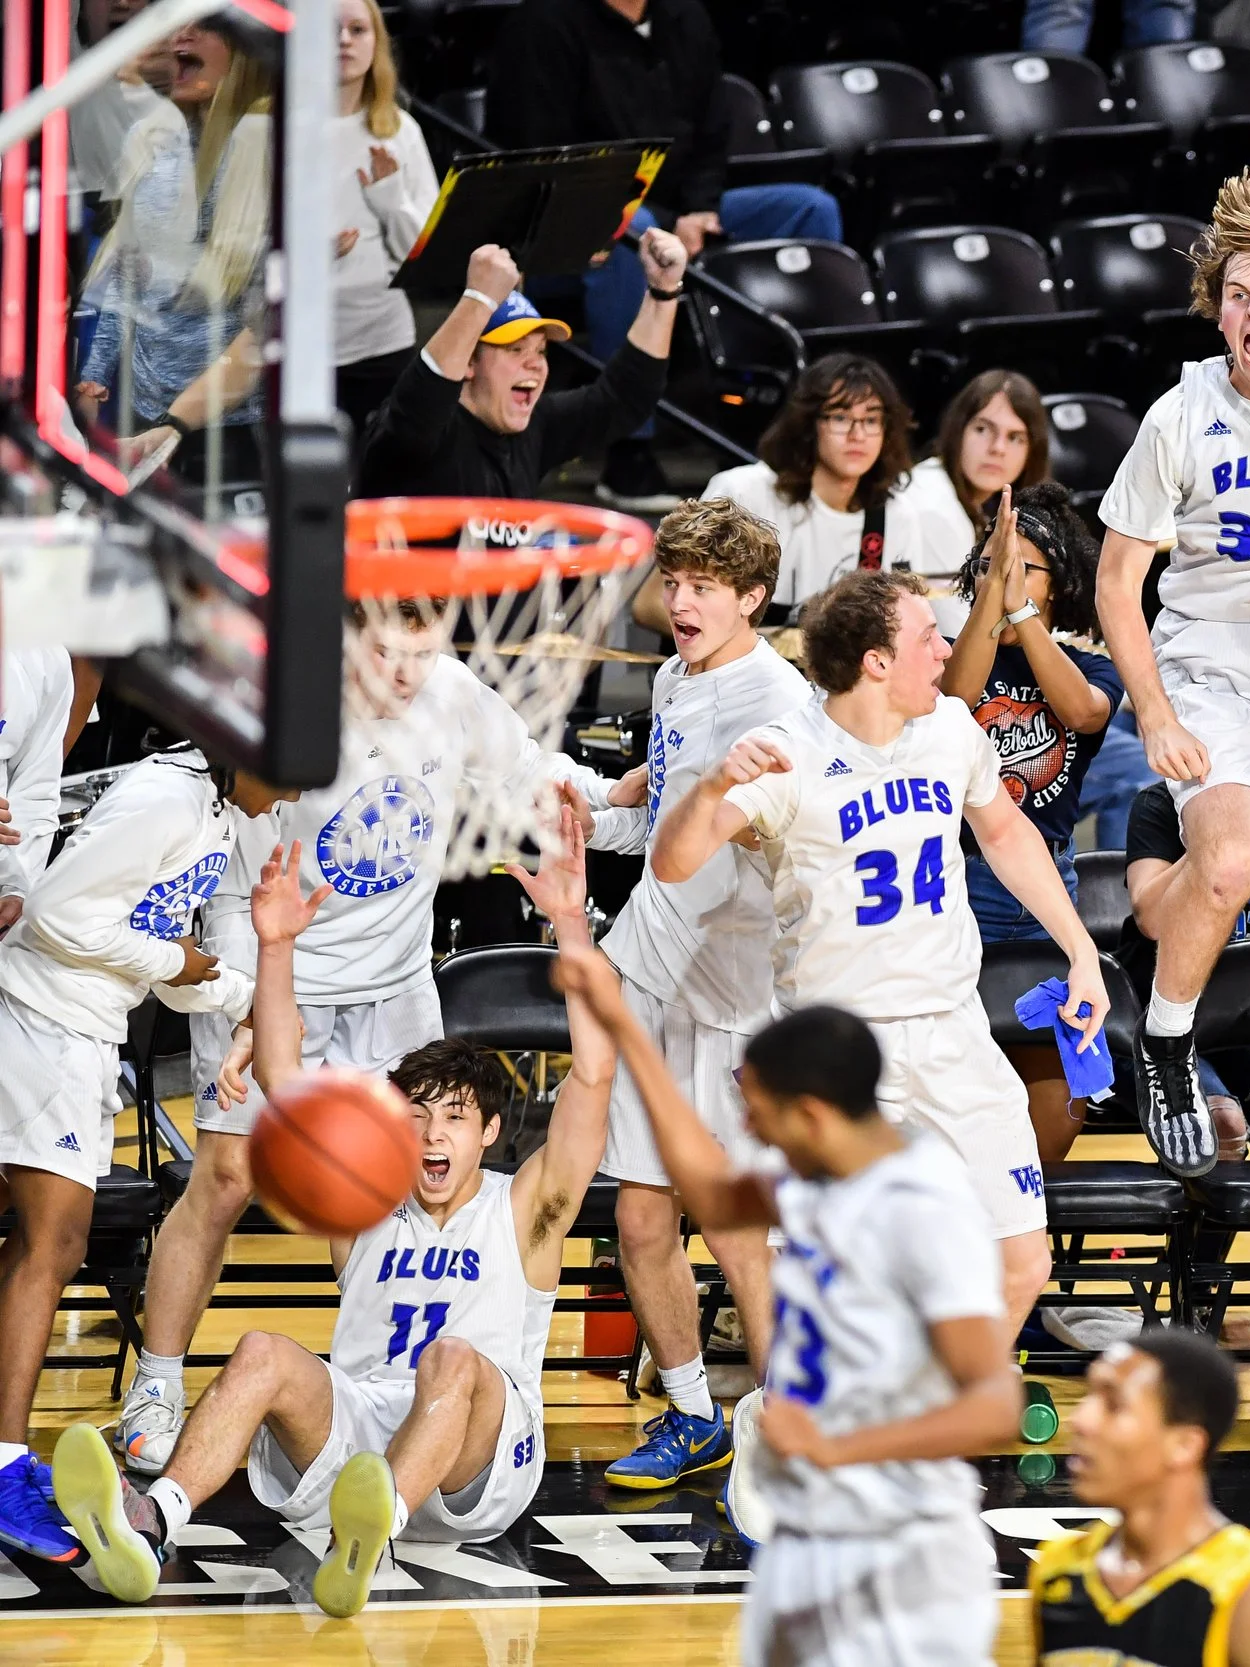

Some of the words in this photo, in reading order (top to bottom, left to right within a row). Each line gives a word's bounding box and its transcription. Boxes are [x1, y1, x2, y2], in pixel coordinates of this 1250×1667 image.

[1204, 428, 1232, 436] adidas
[994, 680, 1041, 702] SATE
[668, 729, 685, 750] CM
[989, 711, 1056, 756] ketball
[421, 756, 442, 776] CM
[824, 767, 853, 778] adidas
[838, 778, 953, 843] BLUES
[320, 858, 418, 896] BASKETB
[854, 834, 945, 926] 34
[1009, 1164, 1044, 1198] WR
[376, 1246, 480, 1283] BLUES
